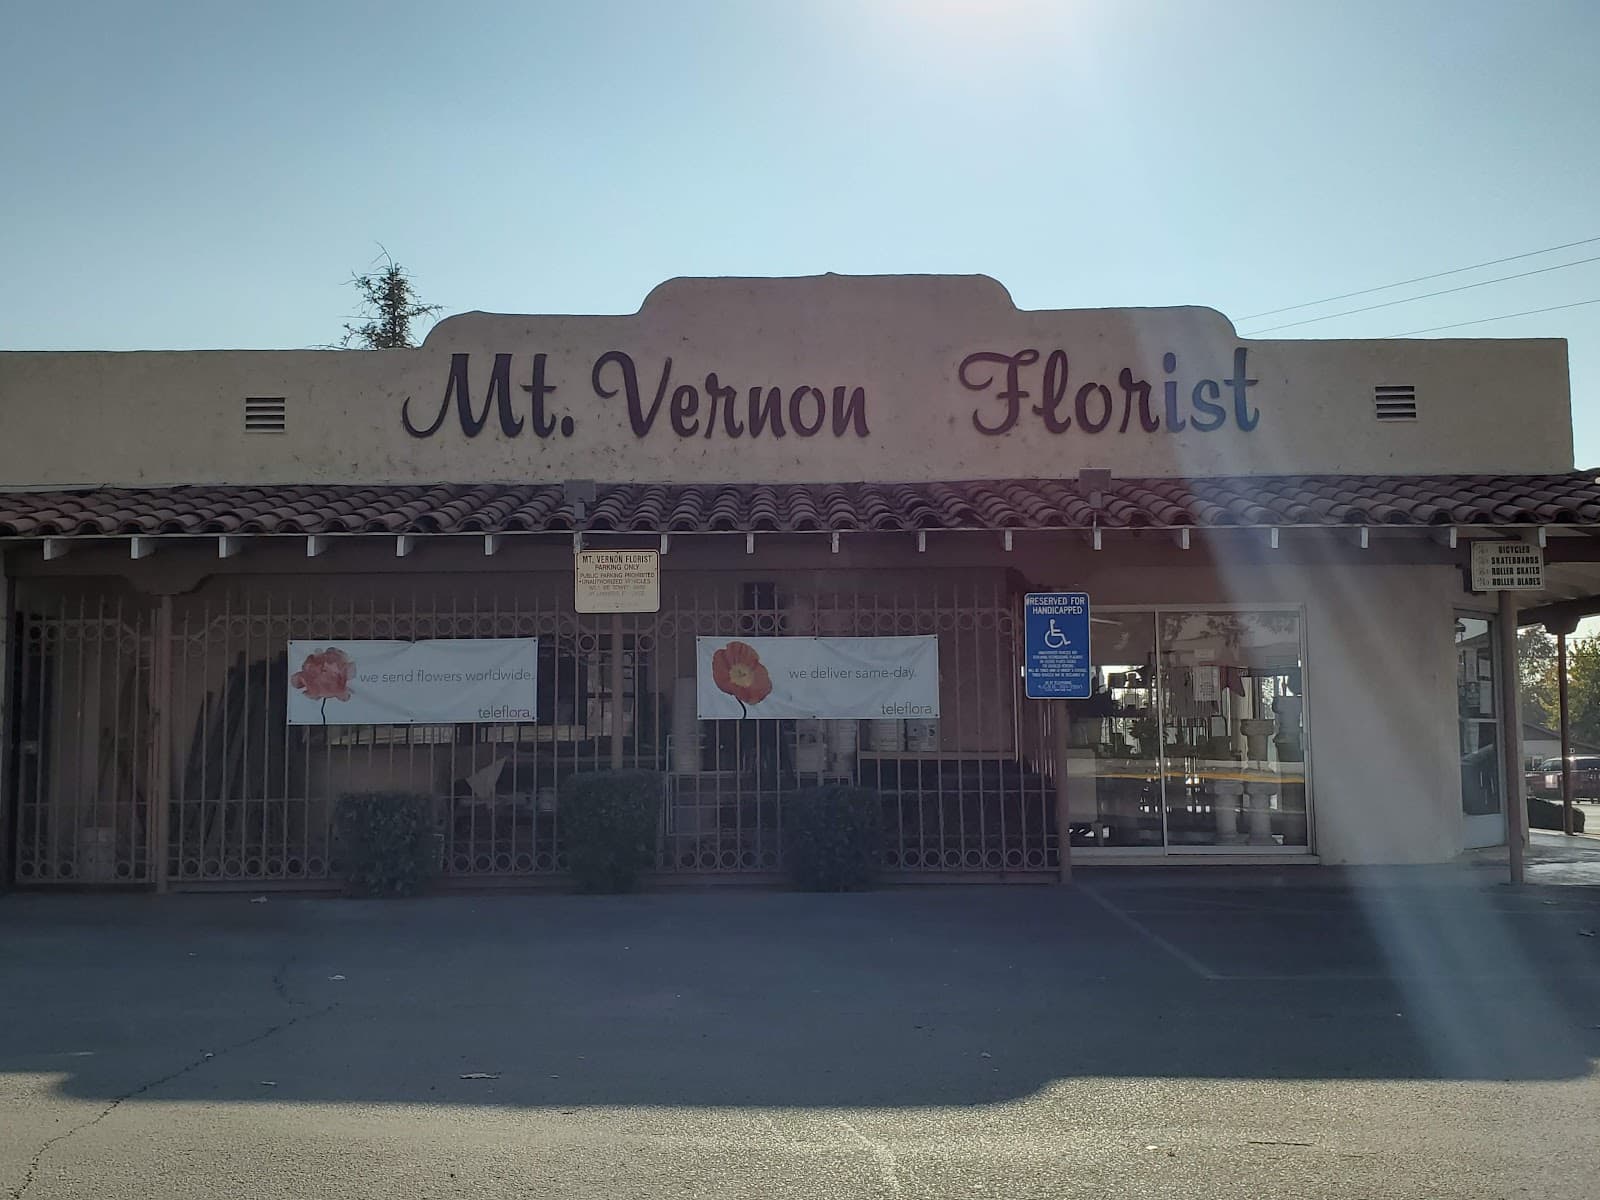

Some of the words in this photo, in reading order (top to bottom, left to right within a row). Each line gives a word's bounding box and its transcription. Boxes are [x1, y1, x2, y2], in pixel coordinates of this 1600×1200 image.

[402, 353, 574, 438] Mt.
[592, 350, 870, 439] Vernon
[958, 347, 1260, 435] Florist
[582, 555, 595, 563] MT.
[596, 555, 623, 563] VERNON
[625, 555, 652, 563] FLORIST
[1491, 556, 1539, 564] SKATEBOARDS
[1517, 578, 1541, 586] BLADES
[1030, 597, 1068, 605] RESERVED
[1070, 597, 1085, 605] FOR
[1032, 606, 1083, 614] HANDICAPPED
[360, 673, 378, 682] we
[381, 670, 413, 682] send
[417, 670, 463, 682] flowers
[464, 669, 534, 681] worldwide.
[789, 669, 807, 679] we
[810, 667, 851, 679] deliver
[855, 666, 917, 680] same-day.
[478, 704, 530, 719] teleflora
[881, 701, 932, 715] teleflora
